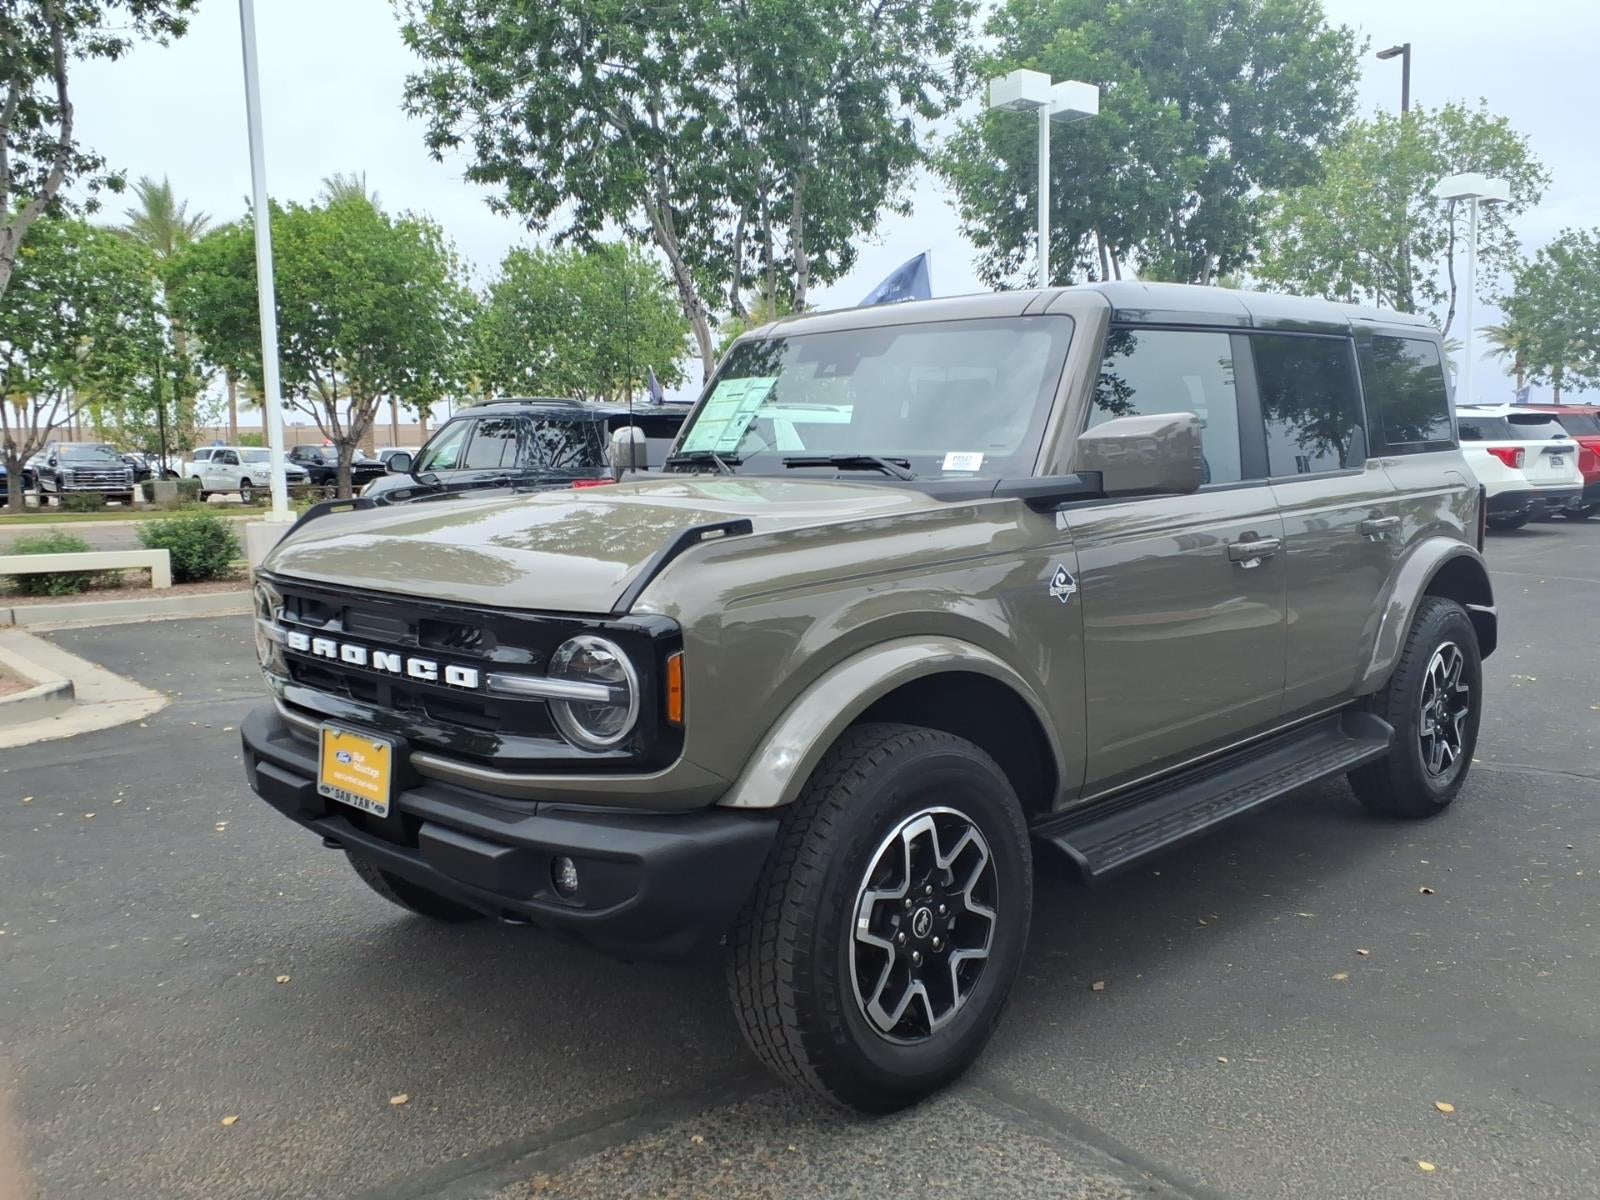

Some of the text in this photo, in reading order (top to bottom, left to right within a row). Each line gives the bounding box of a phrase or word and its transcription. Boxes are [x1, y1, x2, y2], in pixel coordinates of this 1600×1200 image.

[287, 631, 479, 688] BRONCO
[335, 788, 351, 801] SAN
[353, 794, 370, 809] TAN
